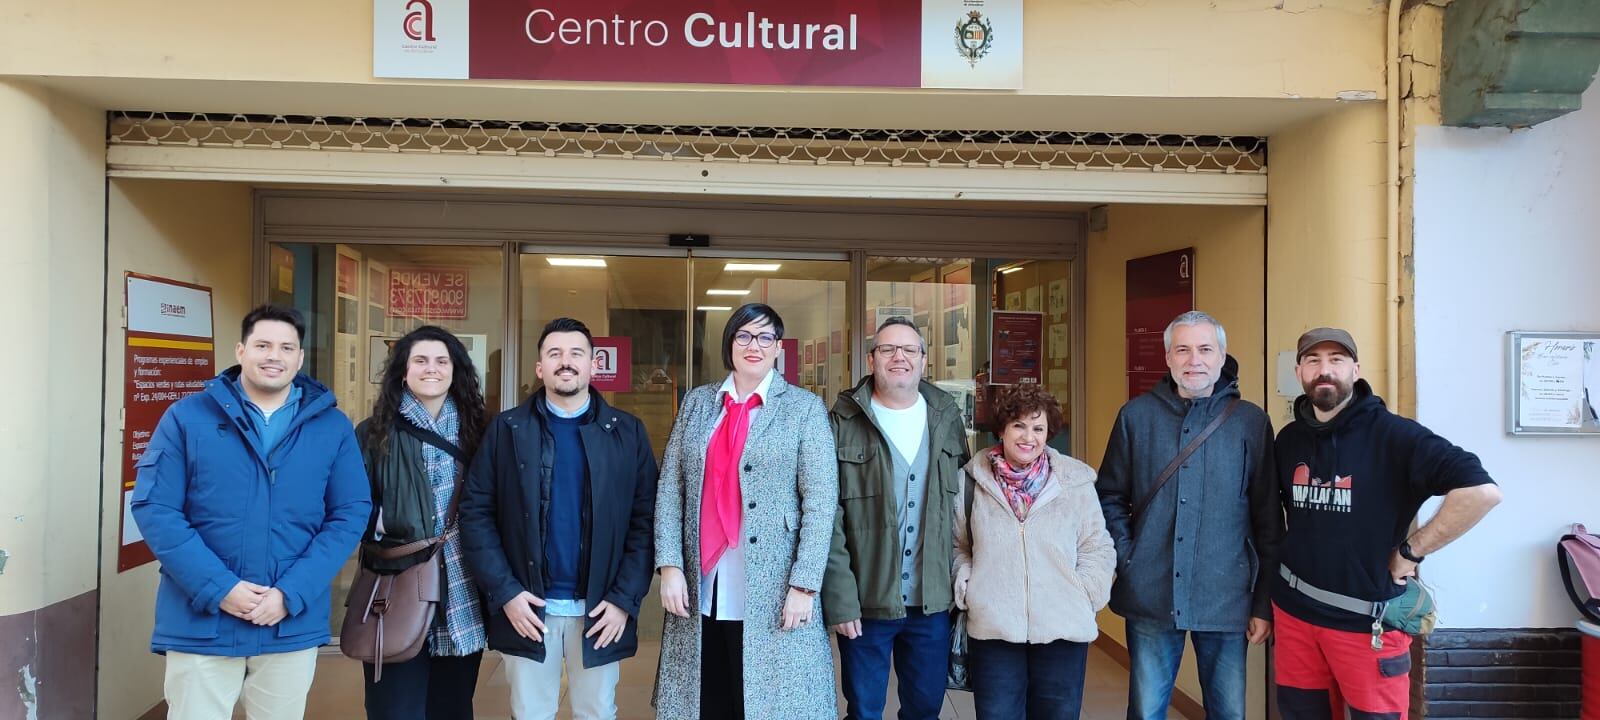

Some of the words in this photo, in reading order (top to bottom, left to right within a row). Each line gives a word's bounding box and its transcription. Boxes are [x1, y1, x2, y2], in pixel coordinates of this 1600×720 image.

[525, 8, 669, 46] Centro
[684, 11, 857, 50] Cultural
[133, 354, 158, 366] Programas
[187, 357, 193, 366] de
[194, 358, 209, 368] empleo
[156, 380, 171, 389] verdes
